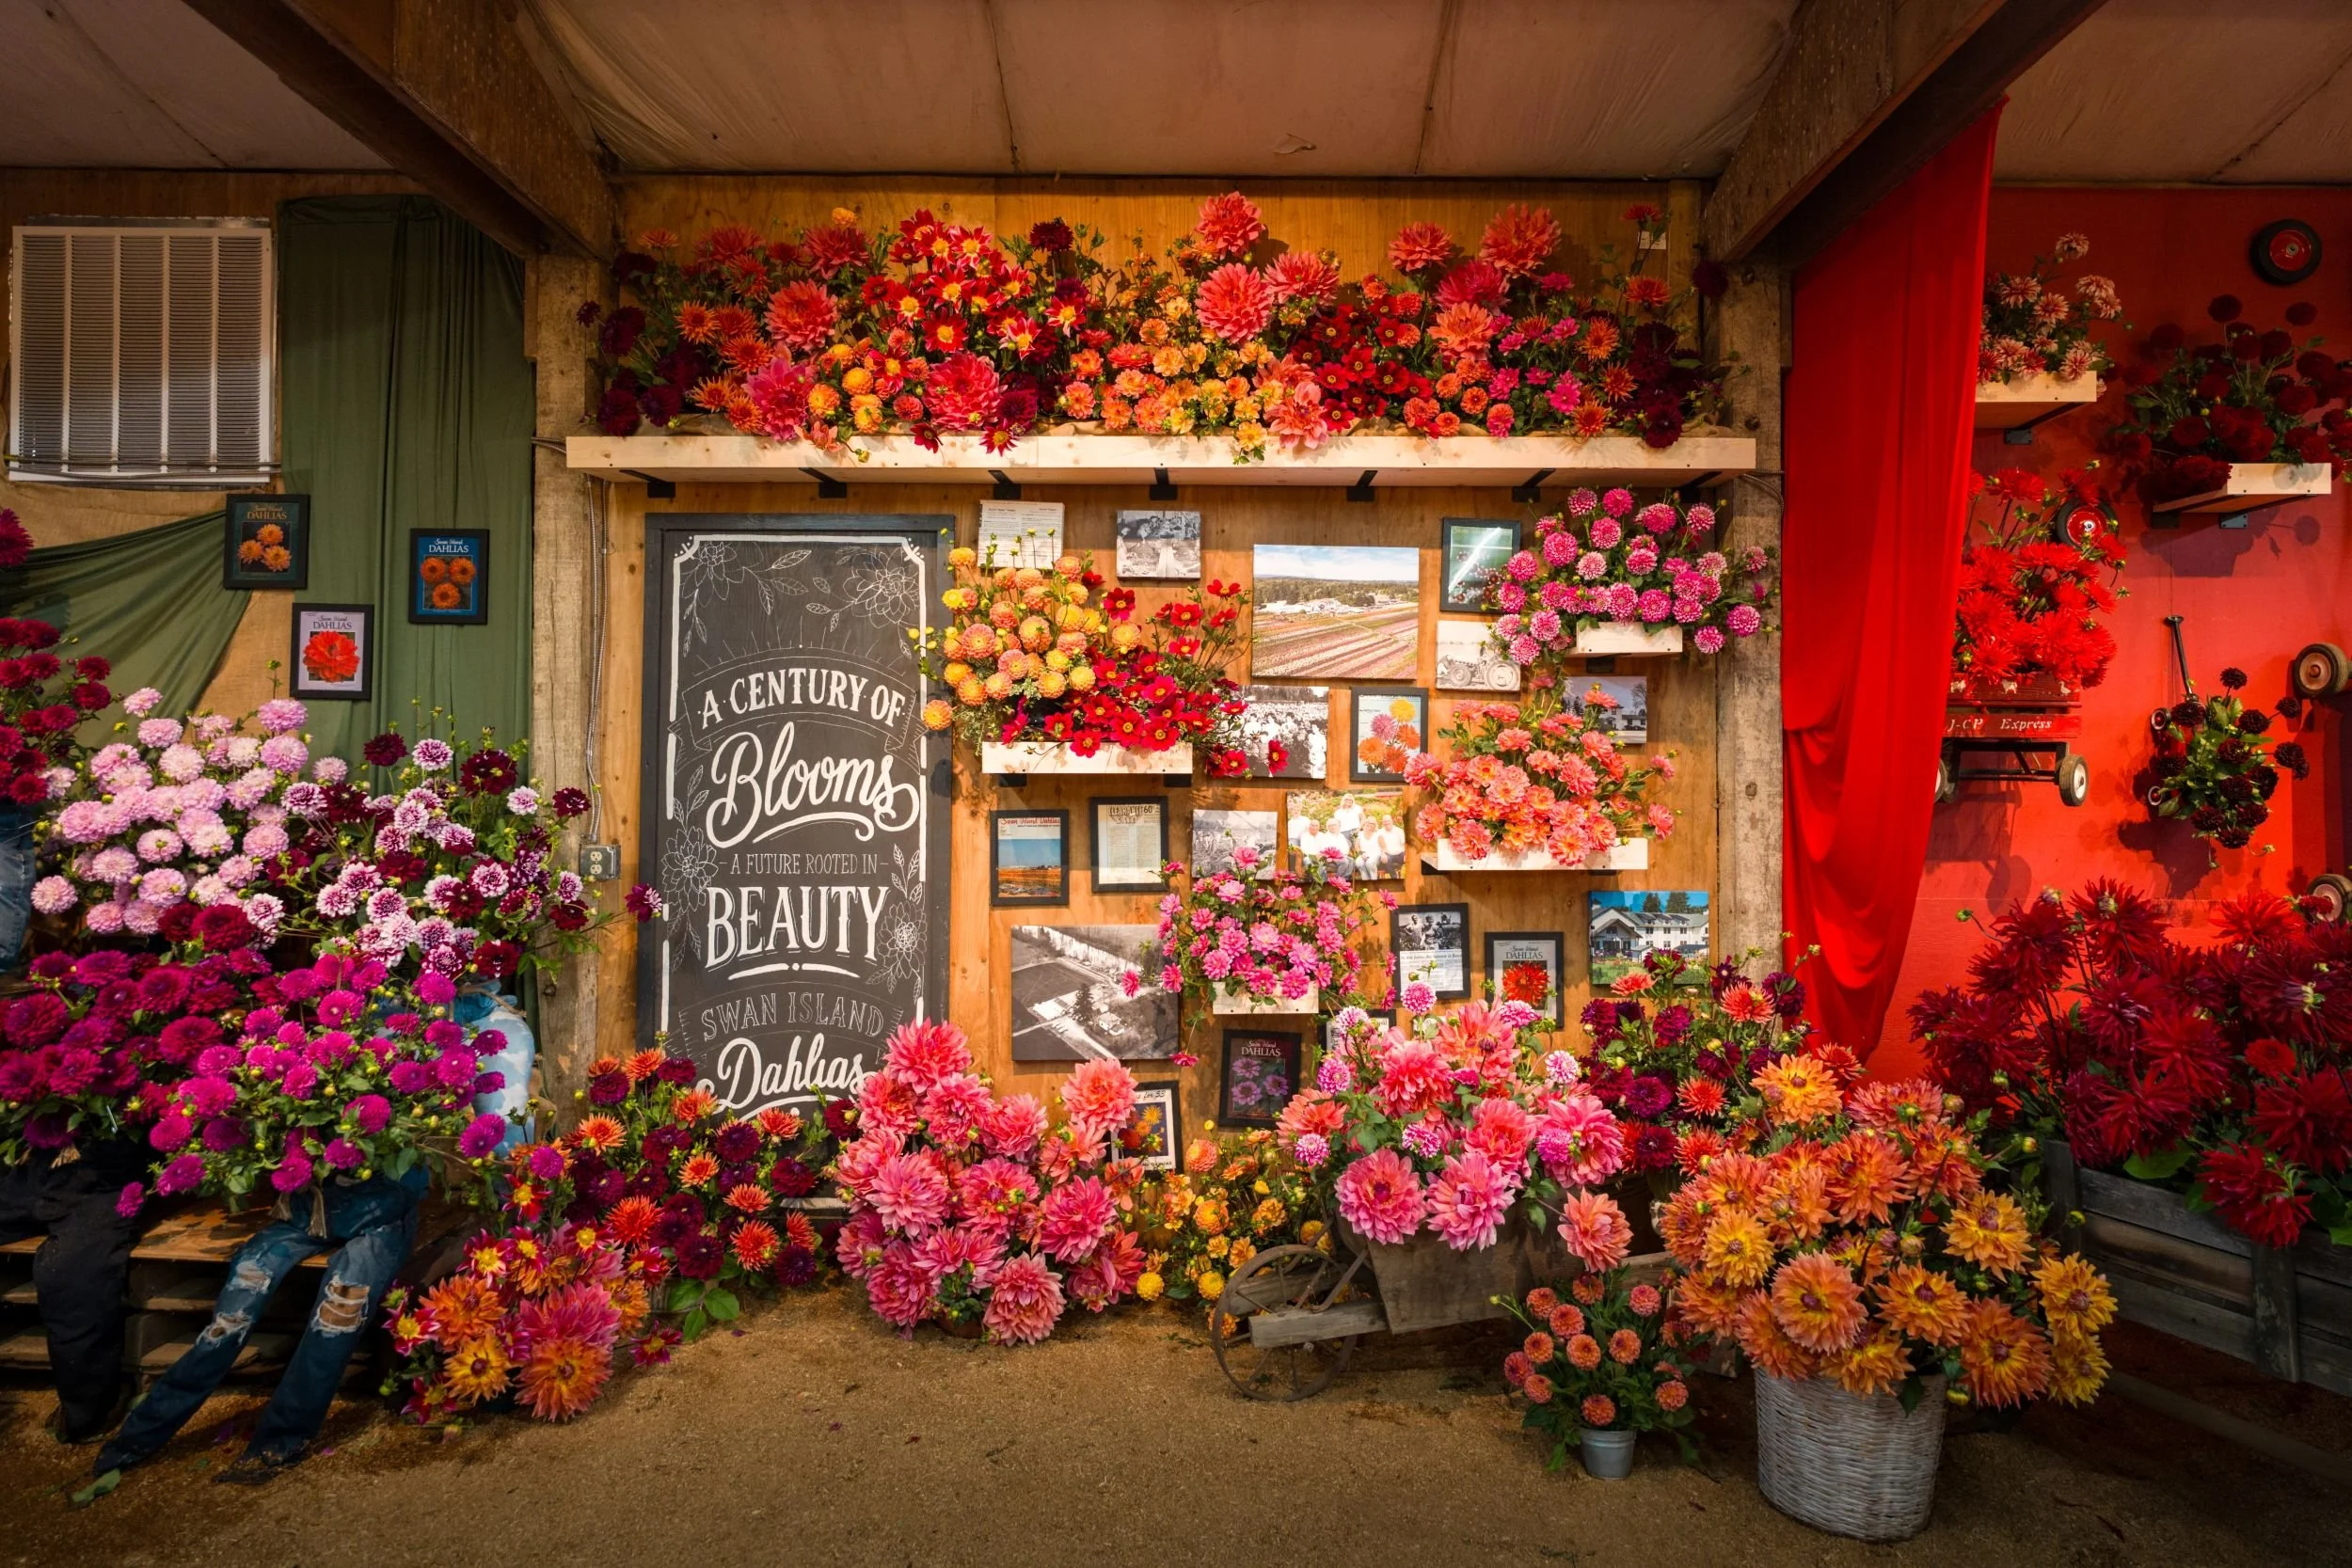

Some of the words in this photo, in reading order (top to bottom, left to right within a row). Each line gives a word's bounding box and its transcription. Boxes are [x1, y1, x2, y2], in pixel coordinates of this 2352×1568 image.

[429, 545, 469, 553] DAHLIAS
[313, 621, 352, 629] DAHLIAS
[701, 689, 723, 729] A
[729, 668, 868, 716] CENTURY
[870, 685, 906, 727] OF
[2000, 718, 2052, 731] Express
[706, 721, 920, 847] Blooms
[730, 854, 741, 874] A
[745, 853, 801, 874] FUTURE
[804, 853, 858, 874] ROOTED
[861, 853, 878, 874] IN
[705, 886, 892, 972] BEAUTY
[1505, 951, 1543, 959] DAHLIAS
[701, 993, 777, 1041] SWAN
[787, 991, 884, 1037] ISLAND
[1241, 1046, 1280, 1056] DAHLIAS
[696, 1033, 879, 1114] Dahlias
